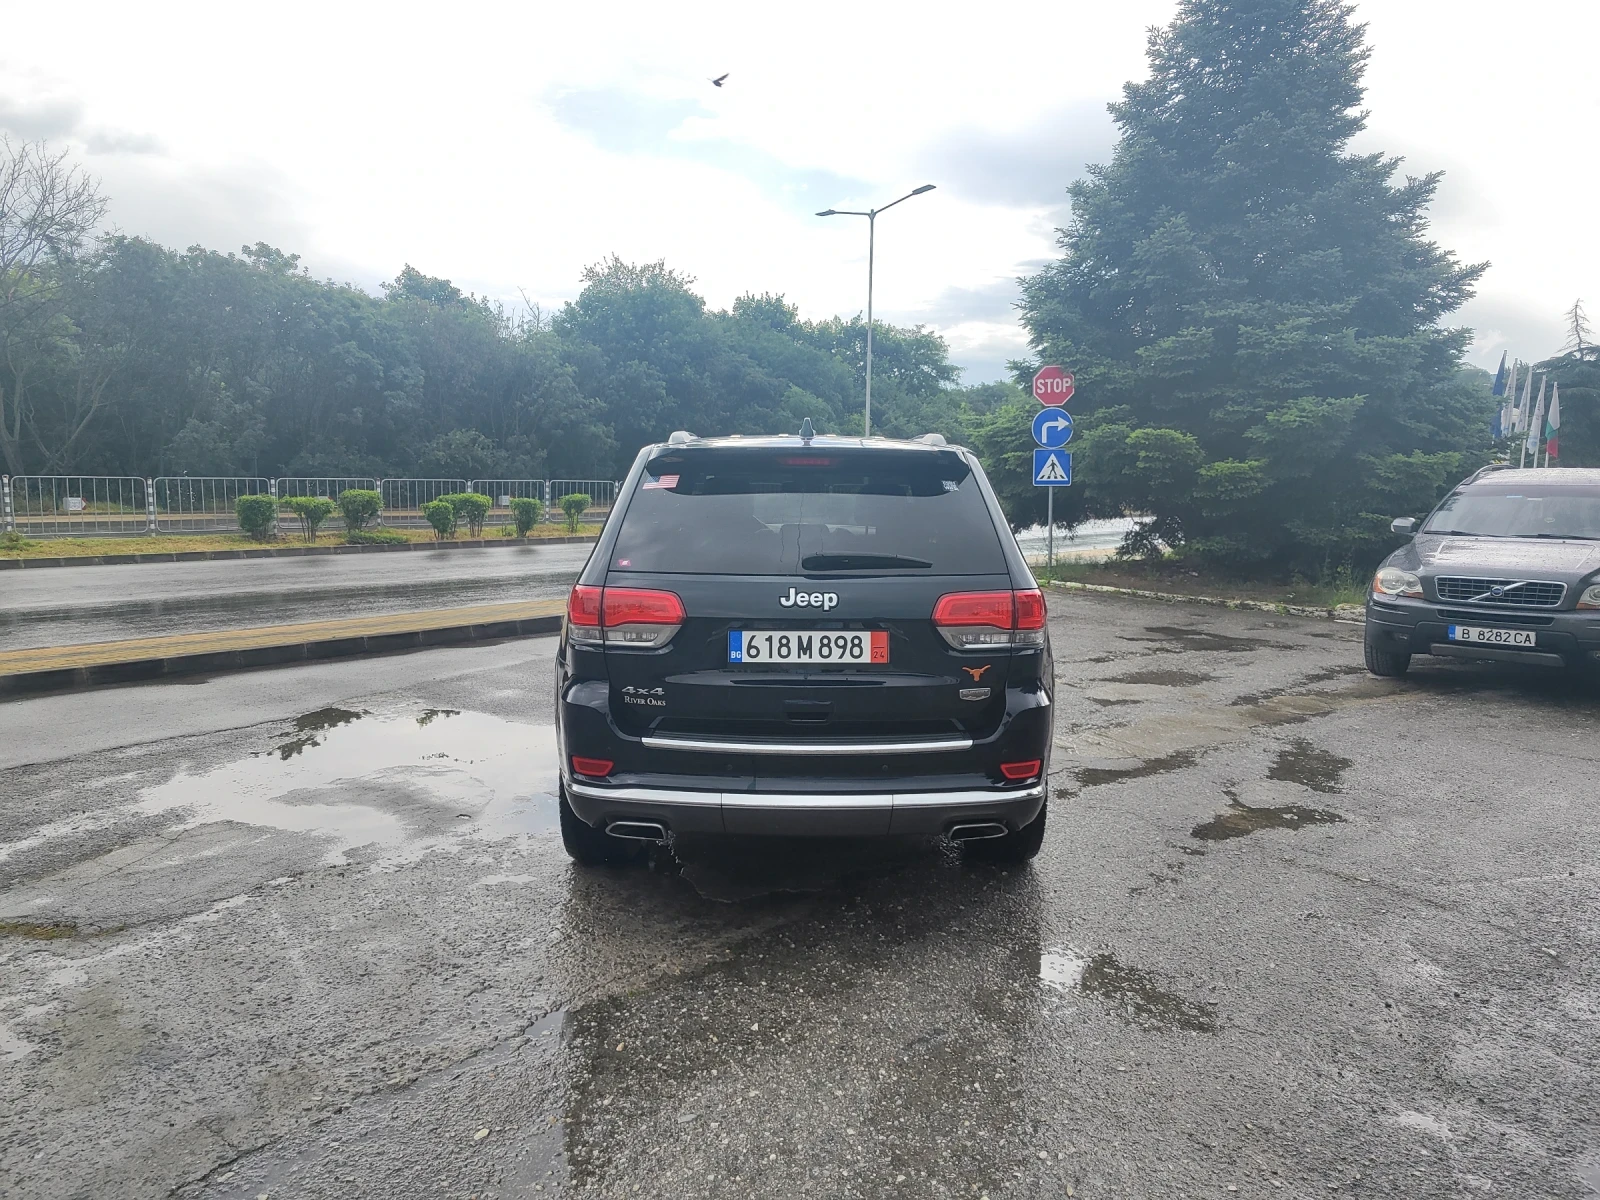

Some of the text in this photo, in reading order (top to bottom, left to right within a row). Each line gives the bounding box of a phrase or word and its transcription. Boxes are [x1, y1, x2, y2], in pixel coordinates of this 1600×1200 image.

[1036, 378, 1071, 394] STOP
[780, 587, 839, 611] Jeep
[1461, 628, 1471, 640] B
[730, 651, 742, 659] BG
[873, 651, 885, 659] 24
